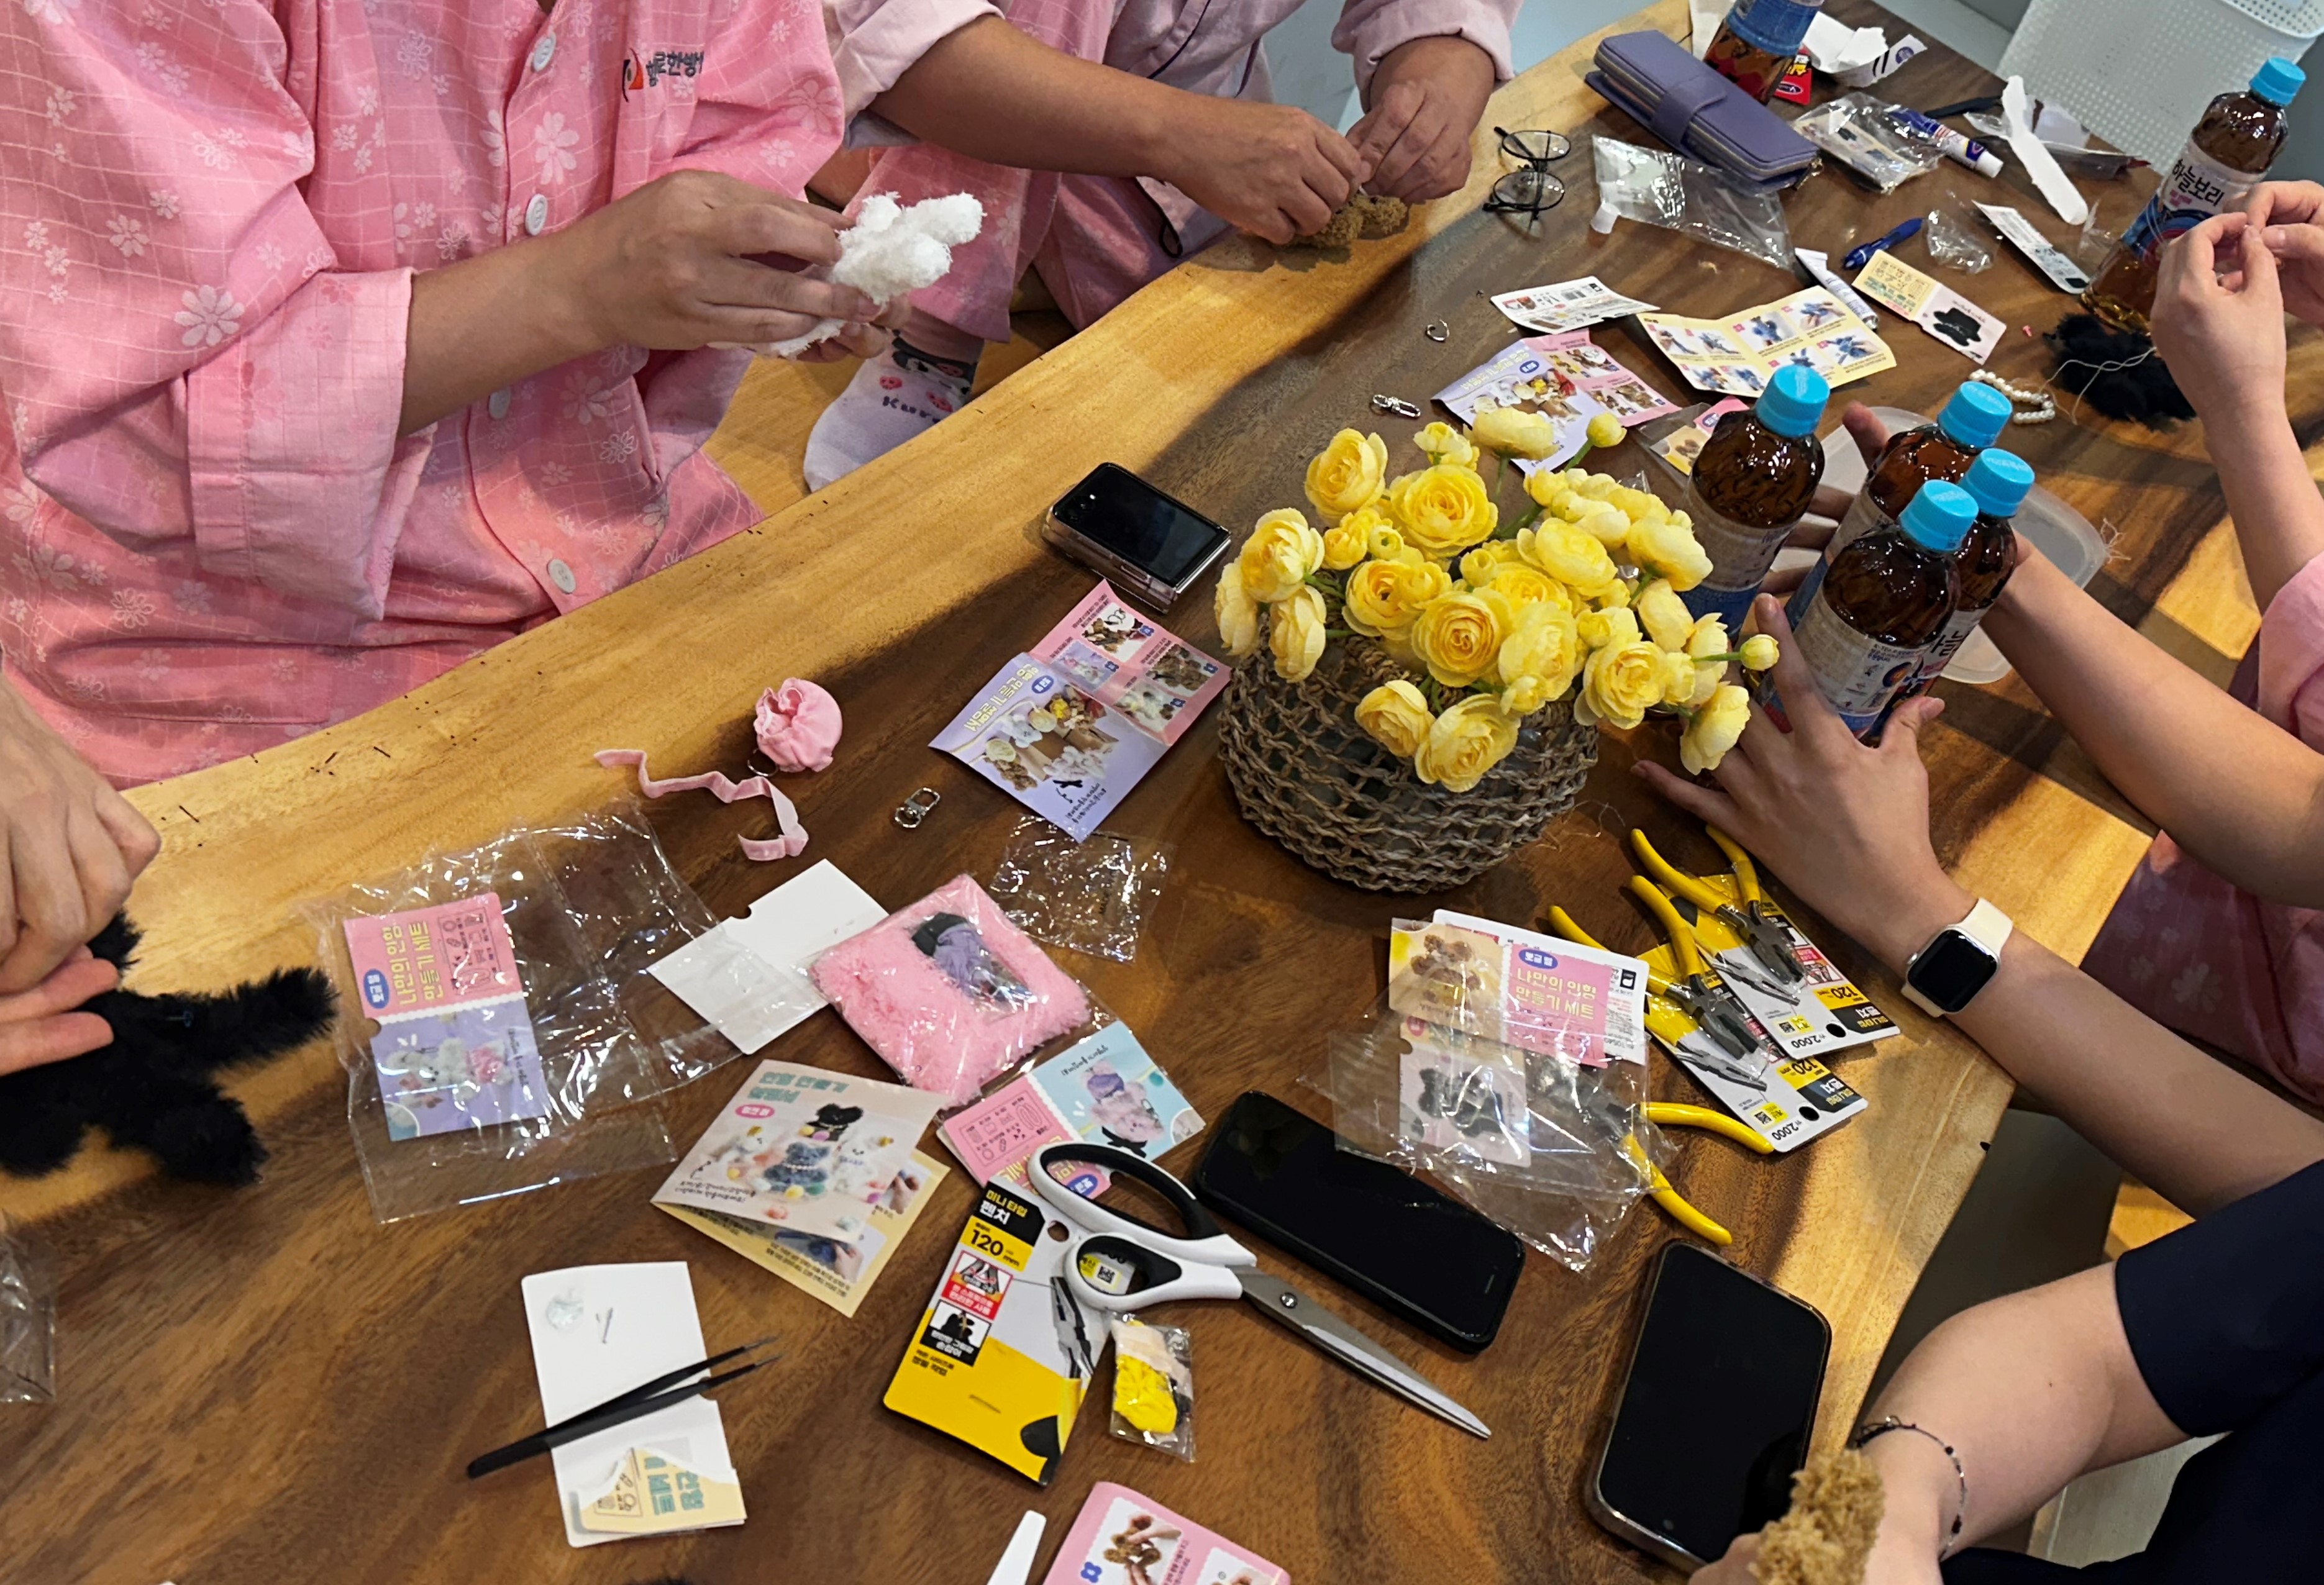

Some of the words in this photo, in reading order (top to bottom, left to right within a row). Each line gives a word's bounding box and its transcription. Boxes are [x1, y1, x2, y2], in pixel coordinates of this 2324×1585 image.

[2172, 159, 2225, 206] 하늘보리
[1018, 663, 1039, 681] 인형
[992, 678, 1023, 706] 만들기
[964, 704, 996, 732] 설명서
[382, 925, 405, 955] 인형
[409, 922, 431, 951] 세트
[391, 958, 417, 1005] 나만의
[417, 955, 443, 1001] 만들기
[1517, 968, 1564, 991] 나만의
[1567, 981, 1597, 999] 인형
[1516, 988, 1561, 1010] 만들기
[1565, 1001, 1595, 1019] 세트
[1832, 988, 1857, 998] 120
[1792, 1060, 1817, 1073] 120
[980, 1201, 1011, 1224] 펜치
[987, 1189, 1006, 1206] 미니
[1006, 1201, 1028, 1217] 타입
[971, 1230, 1005, 1256] 120
[1005, 1256, 1020, 1266] mm
[648, 1474, 675, 1515] 세트
